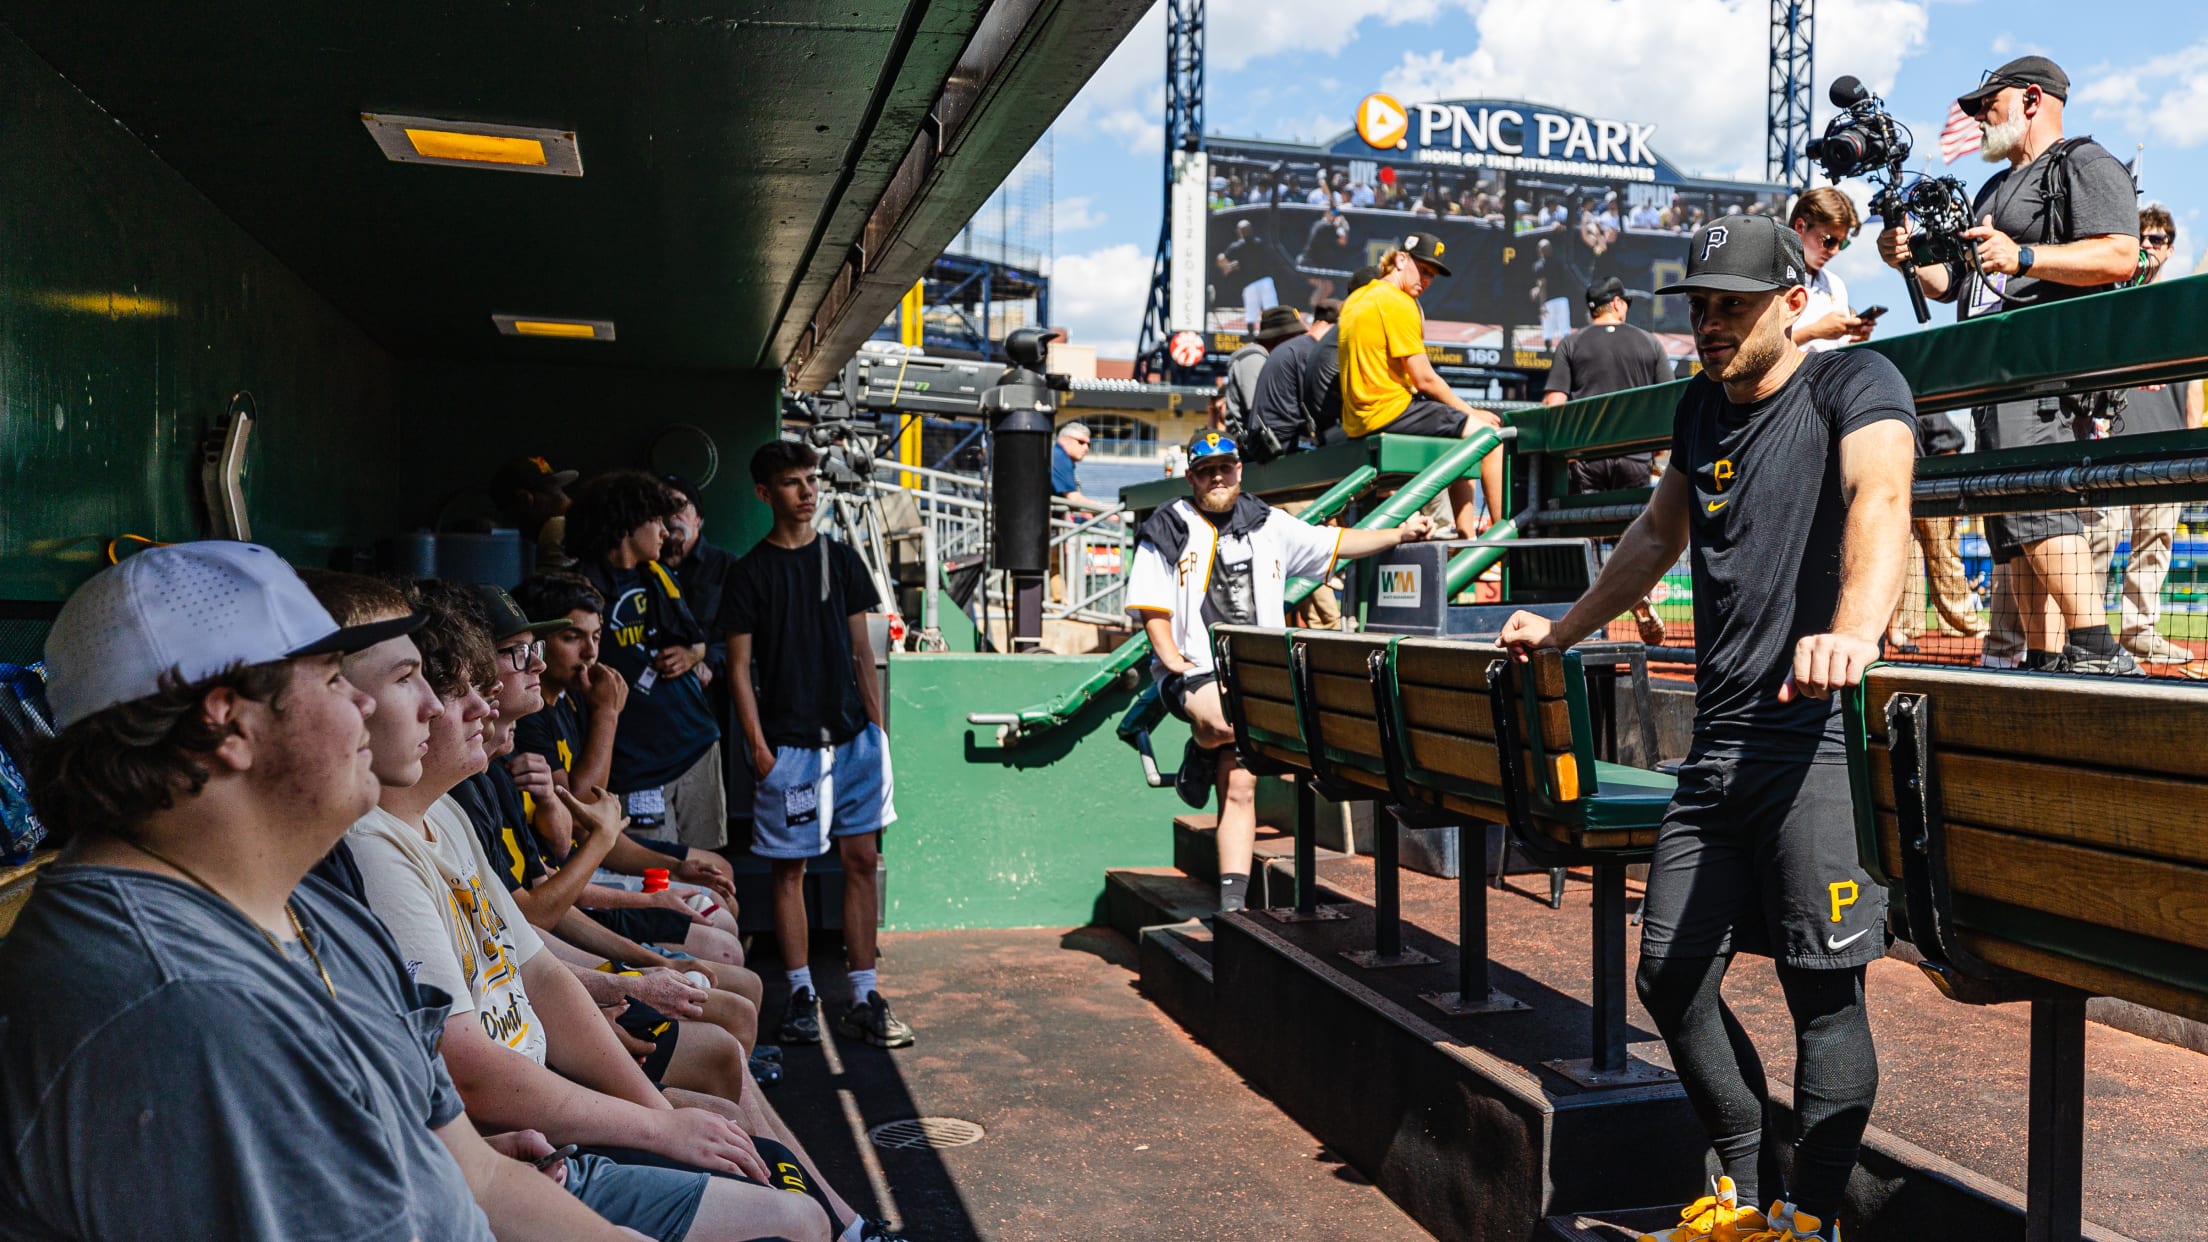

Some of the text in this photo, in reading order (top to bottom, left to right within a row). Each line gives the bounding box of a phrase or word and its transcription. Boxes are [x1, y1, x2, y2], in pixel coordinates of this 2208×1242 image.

[1415, 103, 1658, 166] PNC PARK
[1420, 149, 1656, 183] HOME OF THE PITTSBURGH PIRATES
[1433, 241, 1446, 257] P
[1503, 247, 1516, 265] P
[1700, 225, 1729, 261] P
[1467, 349, 1500, 366] 160
[1714, 458, 1735, 491] P
[1381, 570, 1416, 593] WM
[1828, 879, 1859, 923] P
